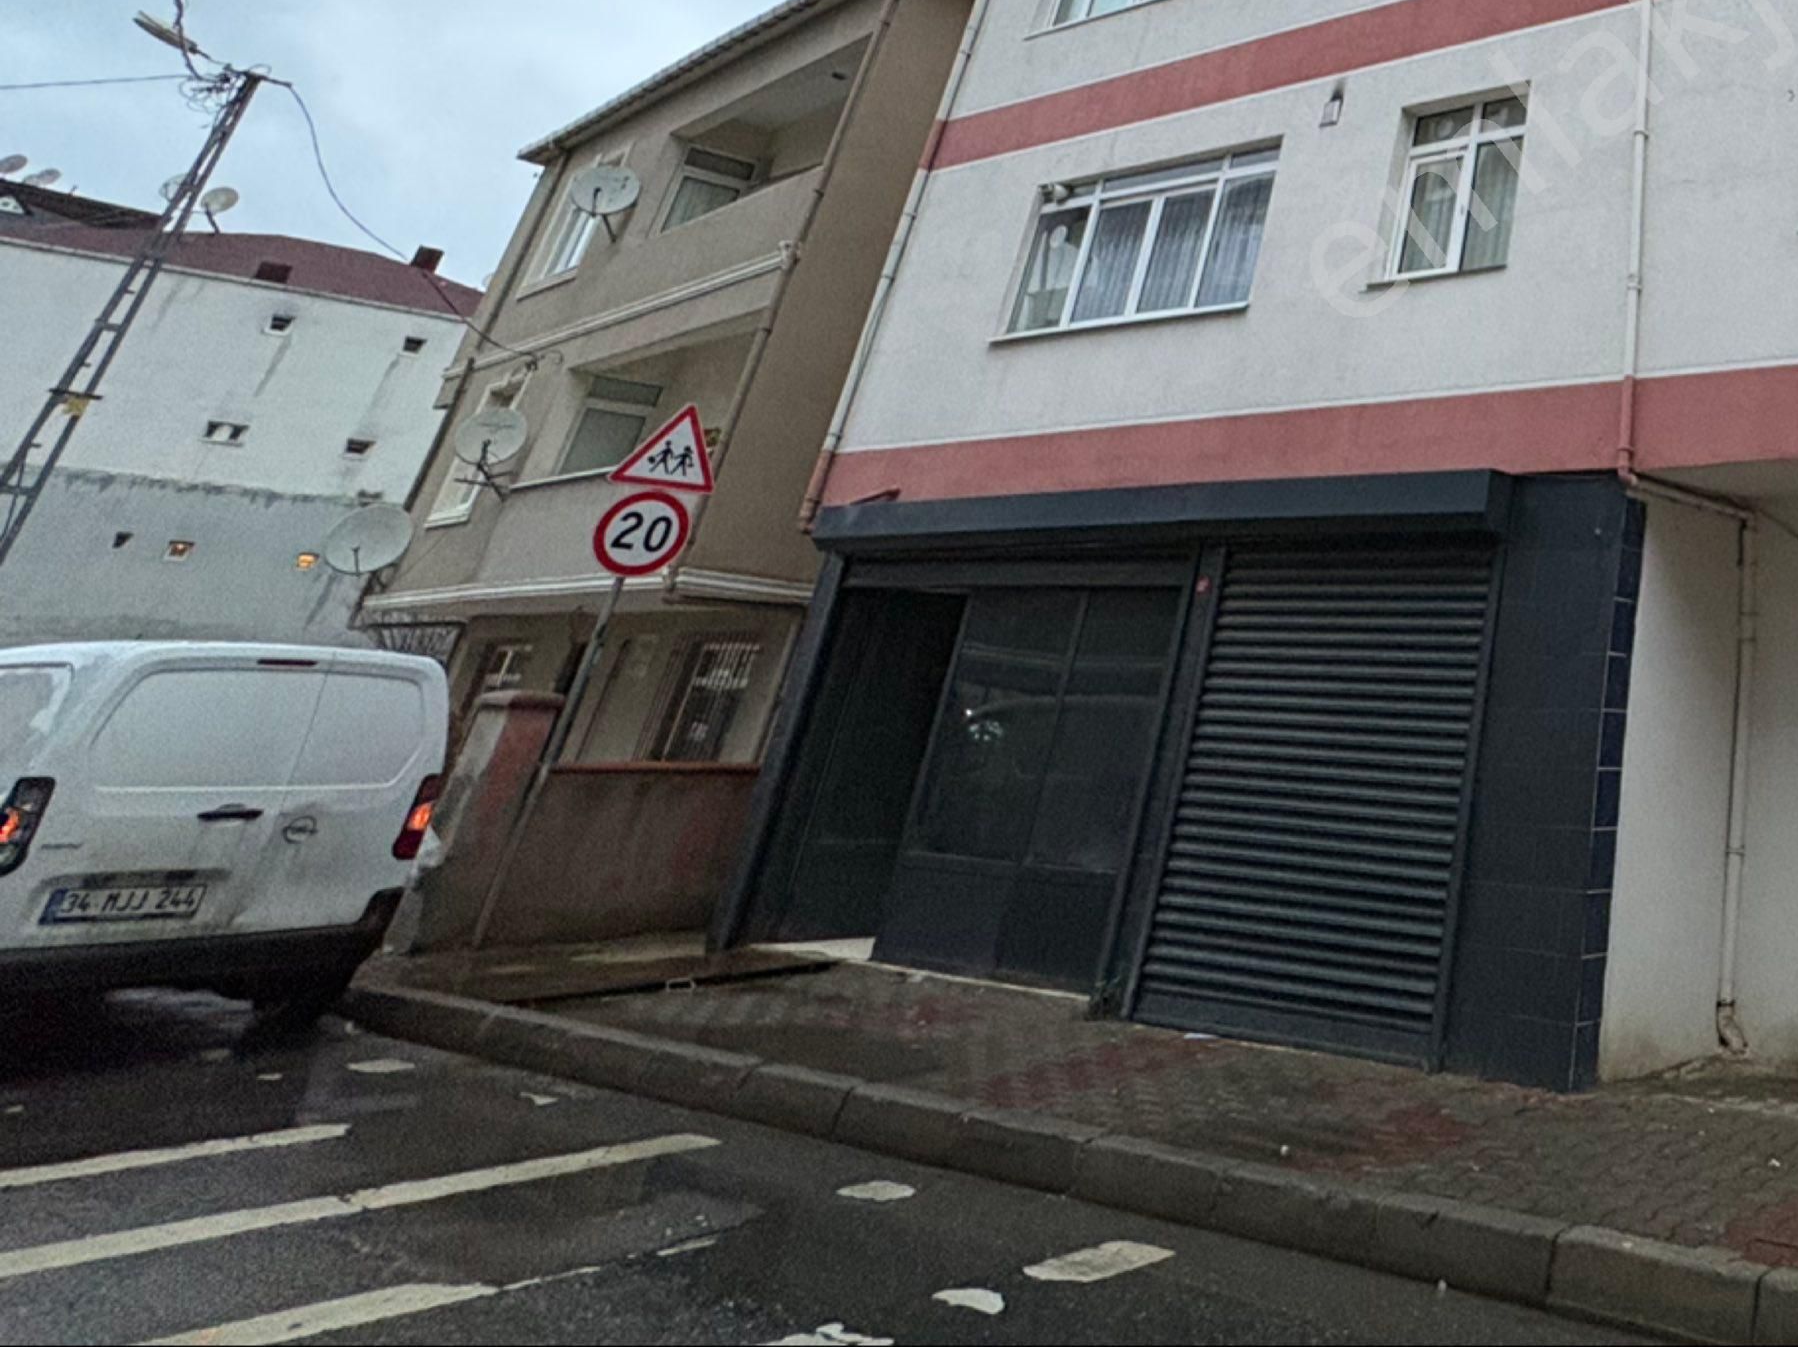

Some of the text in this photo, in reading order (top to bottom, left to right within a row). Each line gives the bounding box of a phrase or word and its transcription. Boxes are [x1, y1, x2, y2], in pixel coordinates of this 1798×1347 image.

[611, 511, 673, 553] 20
[61, 887, 195, 913] 34 MJJ 244
